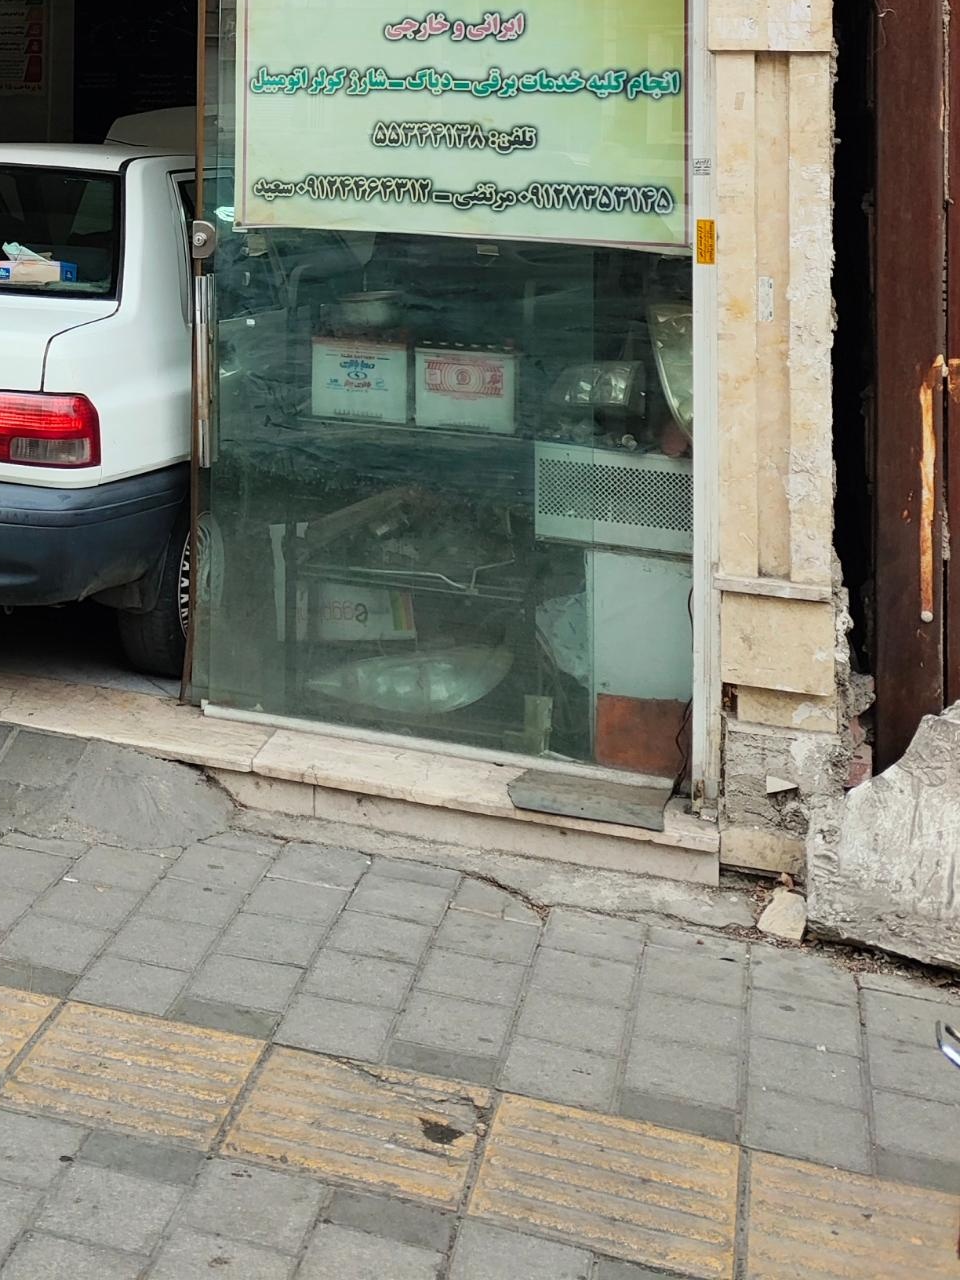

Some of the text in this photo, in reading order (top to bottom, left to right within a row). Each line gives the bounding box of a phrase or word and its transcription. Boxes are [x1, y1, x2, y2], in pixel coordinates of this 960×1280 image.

[384, 12, 525, 40] ایرانی و خارجی
[250, 67, 307, 95] اتومبیل
[307, 68, 347, 95] کولر
[346, 68, 388, 95] شارژ
[406, 68, 451, 95] دیاگ
[471, 68, 517, 97] برقی
[519, 69, 585, 92] خدمات
[587, 70, 627, 98] کلیه
[627, 70, 681, 100] انجام
[373, 121, 537, 154] تلفن: ۵۵۳۴۴۱۳۸
[253, 178, 295, 201] سعید
[296, 175, 431, 203] ۰۹۱۲۴۴۶۴۳۱۲
[453, 182, 516, 211] مرتضی
[518, 182, 674, 214] ۰۹۱۲۷۳۵۳۱۴۵
